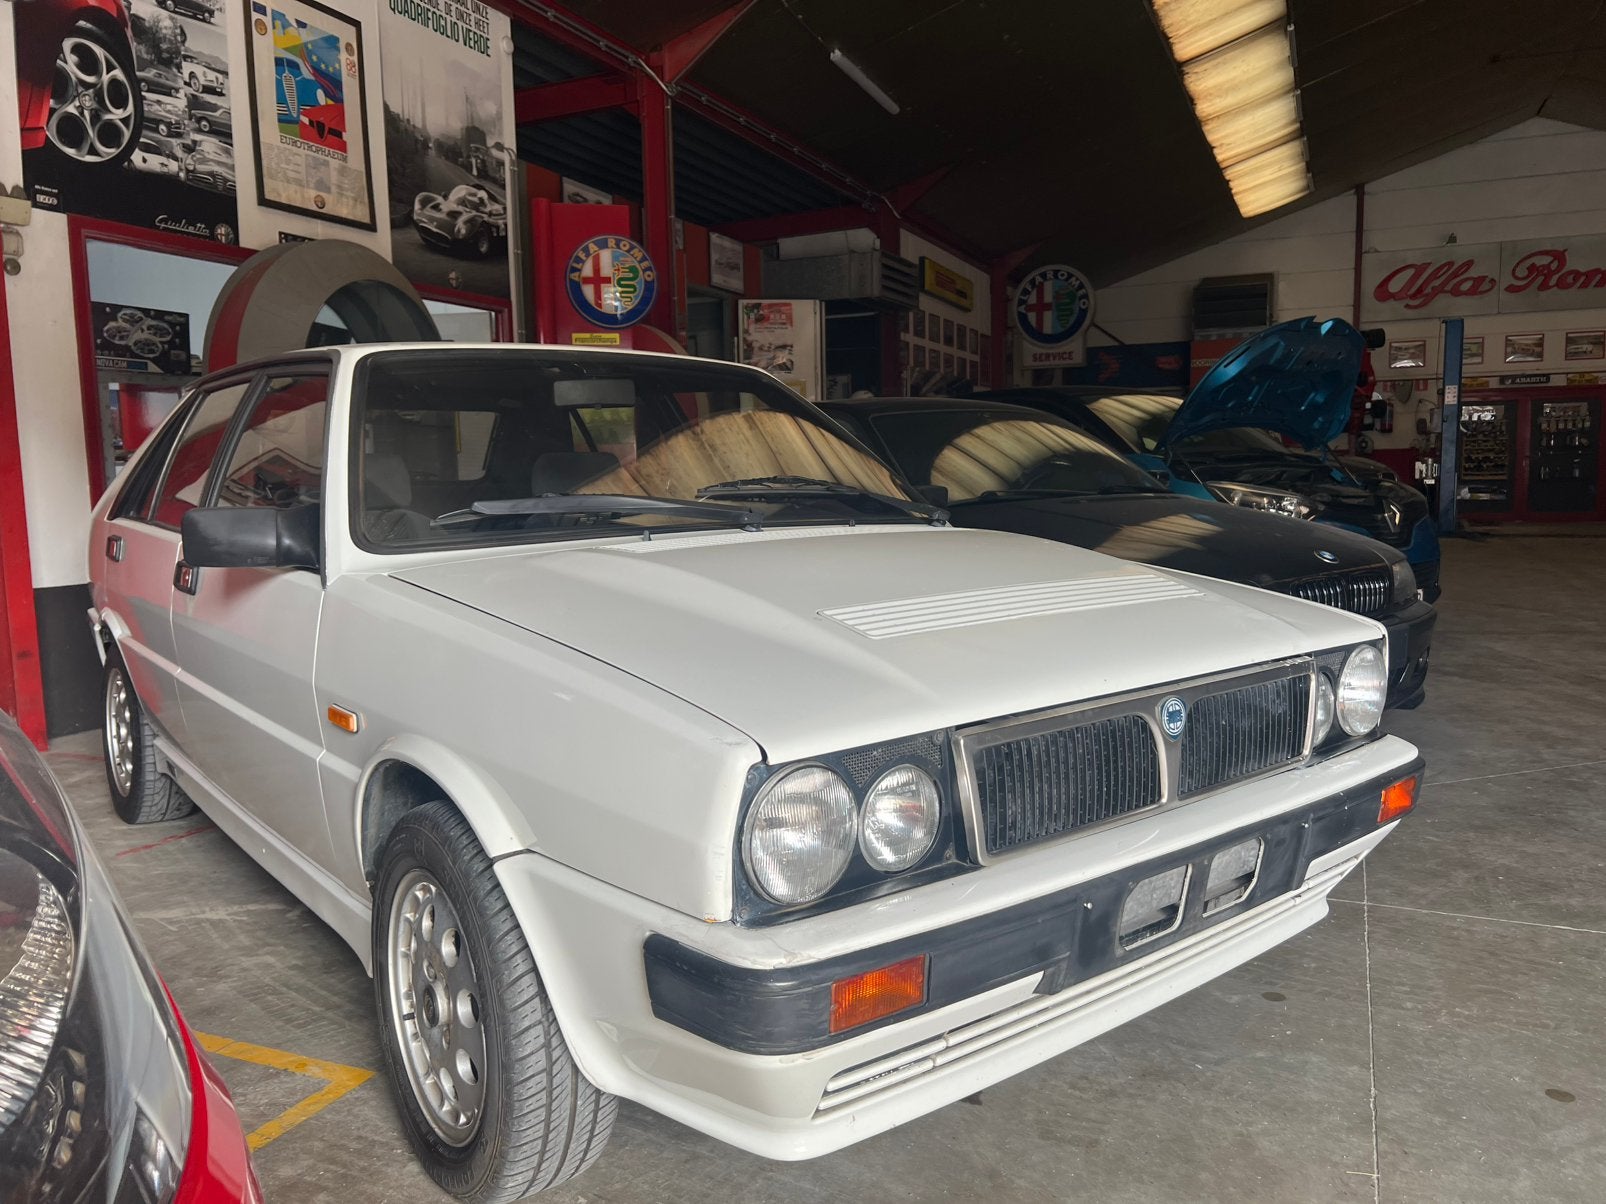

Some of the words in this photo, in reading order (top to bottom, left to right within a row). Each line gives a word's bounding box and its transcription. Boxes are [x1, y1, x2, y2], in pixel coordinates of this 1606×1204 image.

[389, 0, 460, 42] QUADRIFOGLIO
[461, 25, 492, 57] VERDE
[445, 1, 453, 17] DE
[455, 7, 473, 27] ONZE
[474, 16, 490, 35] HEET
[569, 241, 600, 283] ALFA
[607, 237, 656, 282] ROMEO
[1017, 273, 1045, 314] ALFA
[1046, 270, 1089, 310] ROMEO
[1374, 258, 1498, 309] Alfa
[1032, 351, 1075, 363] SERVICE
[1514, 375, 1550, 385] ABARTH
